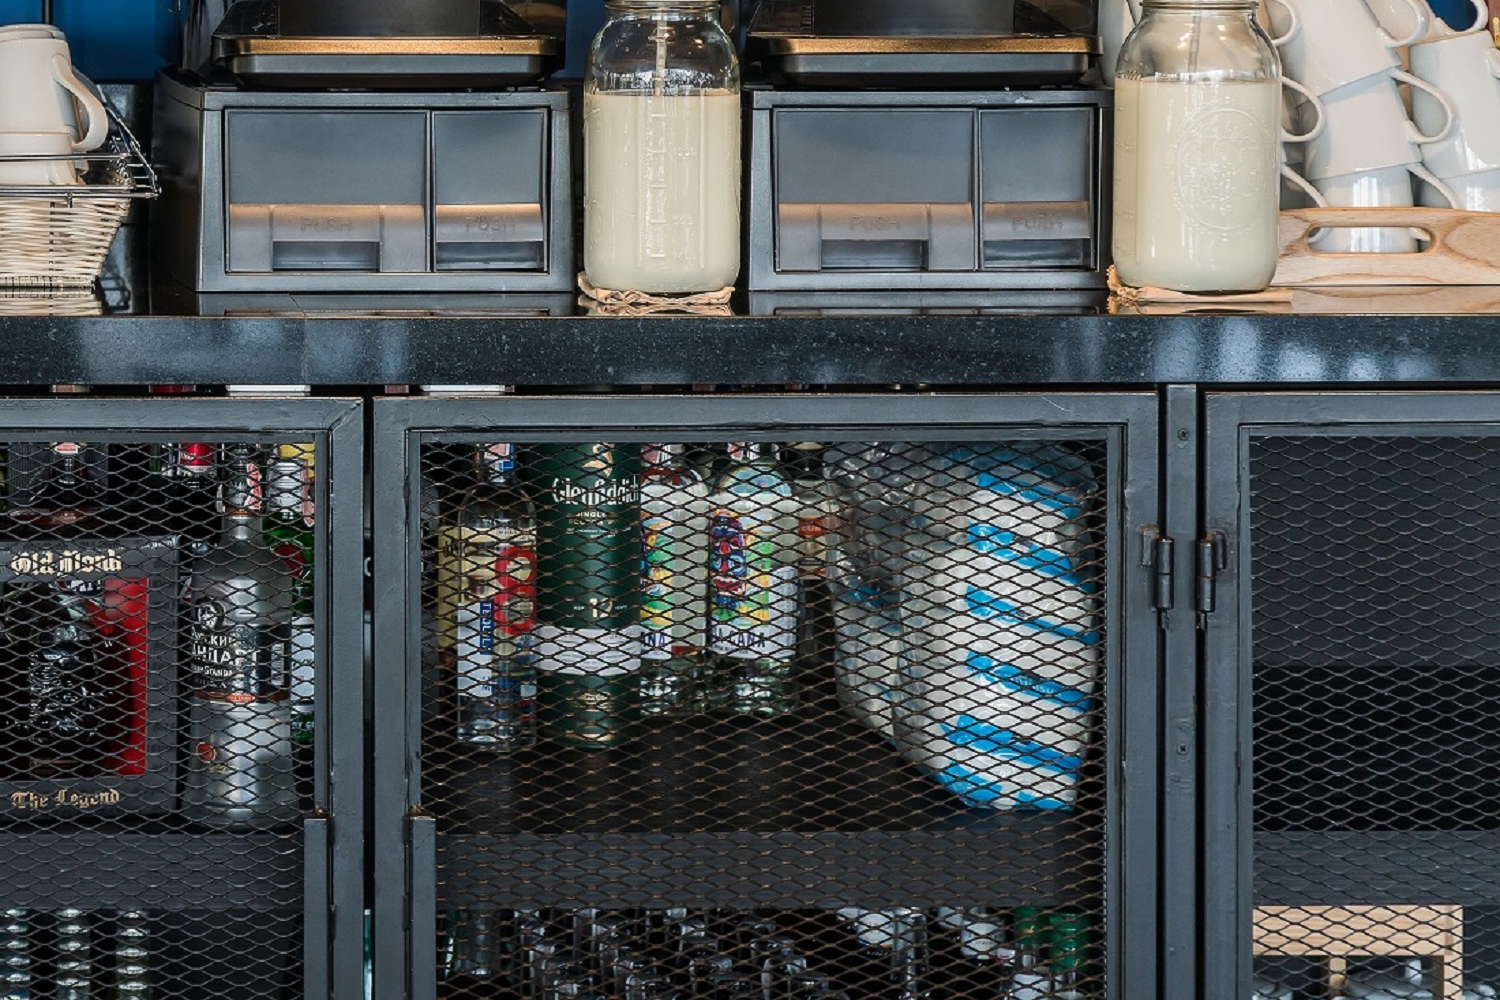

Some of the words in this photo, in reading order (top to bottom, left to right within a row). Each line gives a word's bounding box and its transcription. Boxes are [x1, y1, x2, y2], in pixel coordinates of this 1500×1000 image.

[300, 215, 352, 232] PUSH
[850, 215, 901, 231] PUSH
[1011, 213, 1064, 231] PUSH
[11, 790, 49, 811] The
[55, 787, 121, 810] Legend
